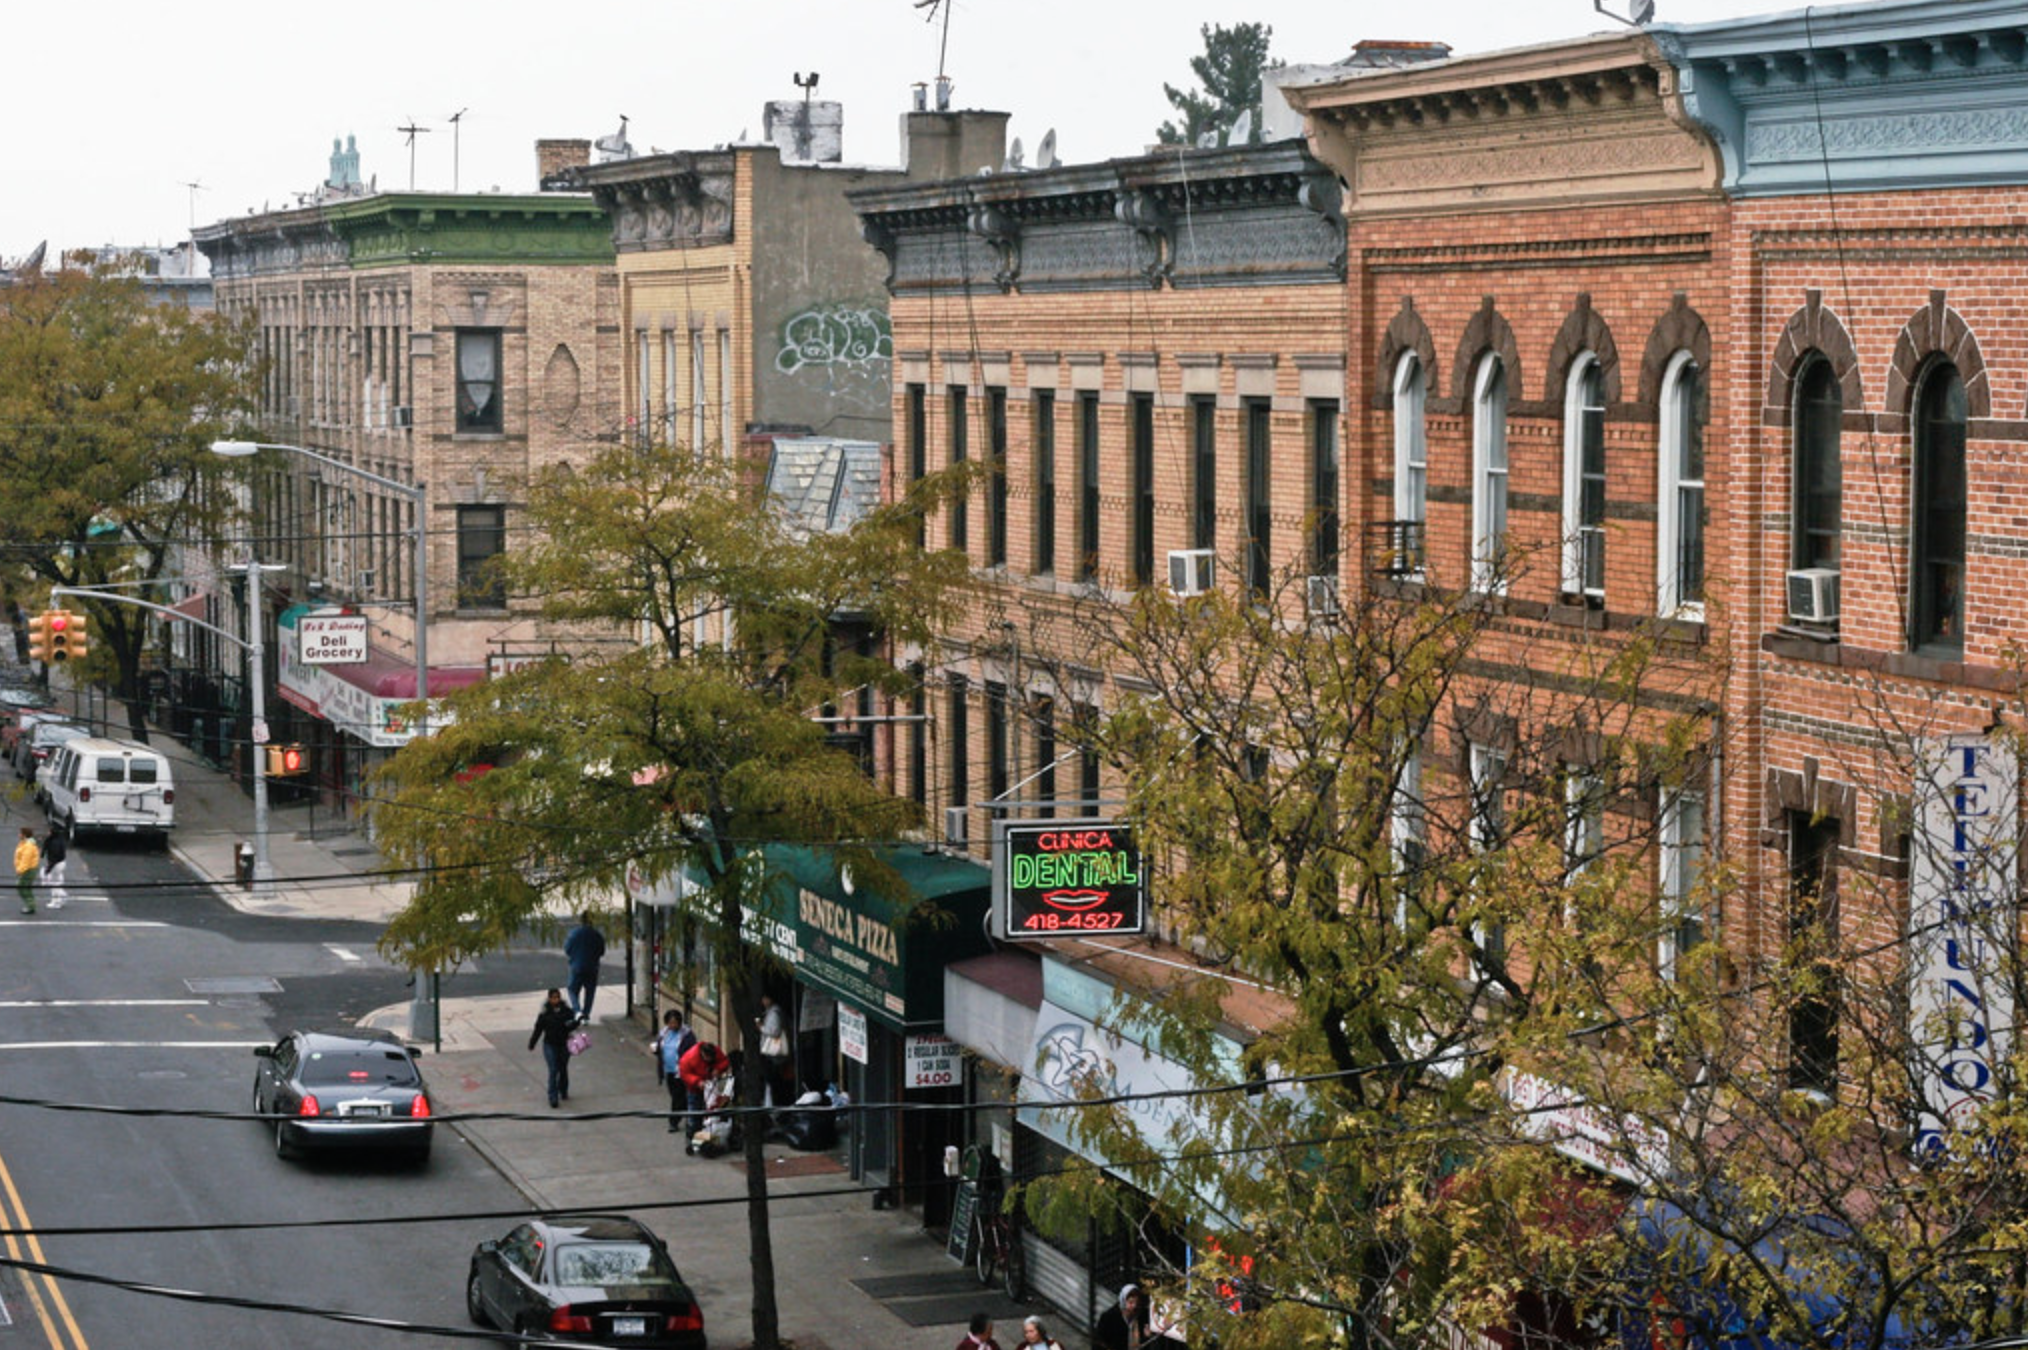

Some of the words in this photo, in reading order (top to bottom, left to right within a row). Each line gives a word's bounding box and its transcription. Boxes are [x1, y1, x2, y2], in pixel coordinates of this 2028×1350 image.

[320, 635, 347, 647] Deli
[305, 647, 363, 660] Grocery
[1037, 831, 1113, 850] CLINICA
[1013, 851, 1137, 889] DENTAL
[800, 888, 855, 945] SENECA
[857, 913, 899, 967] PIZZA
[1024, 912, 1124, 931] 418-4527
[915, 1071, 953, 1085] $4.00
